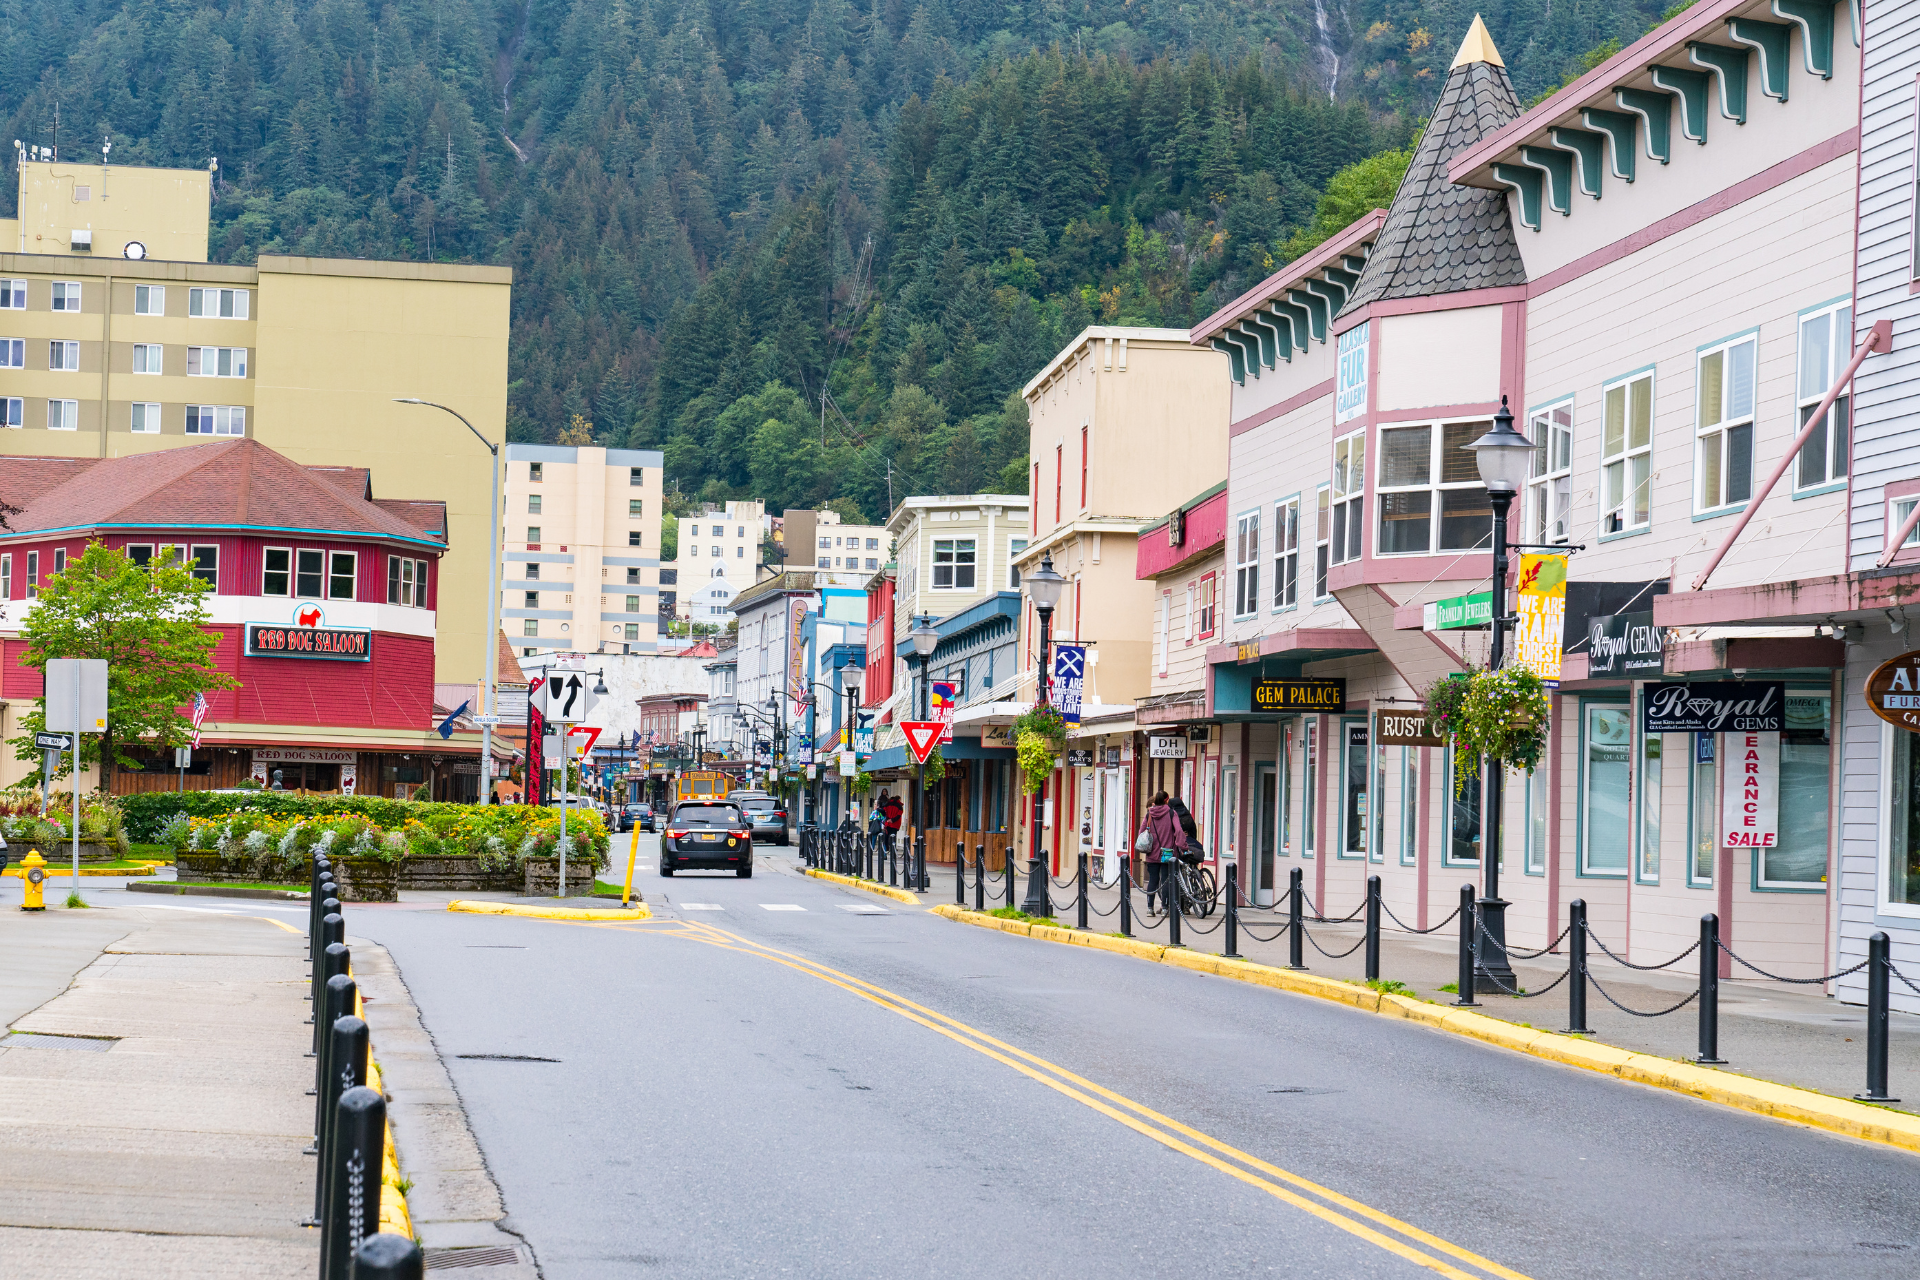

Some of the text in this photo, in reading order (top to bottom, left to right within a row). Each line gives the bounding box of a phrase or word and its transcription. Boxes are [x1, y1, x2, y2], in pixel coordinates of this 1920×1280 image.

[1339, 322, 1370, 356] ALASKA
[1340, 347, 1365, 392] FUR
[1337, 384, 1367, 413] GALLERY
[1439, 605, 1463, 624] FRANKLIN
[1464, 601, 1491, 625] JEWELERS
[1518, 594, 1565, 615] WE ARE
[1515, 612, 1565, 645] RAIN
[258, 629, 365, 654] RED DOG SALOON
[1630, 625, 1661, 655] GEMS
[1514, 640, 1563, 663] FOREST
[1054, 675, 1083, 690] WE ARE
[1888, 667, 1920, 691] A
[1052, 694, 1064, 703] AND
[1256, 686, 1340, 704] GEM PALACE
[1786, 698, 1821, 707] OMEGA
[931, 707, 954, 716] WE ARE
[1383, 716, 1425, 737] RUST
[1733, 717, 1779, 730] GEMS
[39, 736, 61, 746] ONE WAY
[856, 732, 864, 740] WE
[256, 750, 353, 761] RED DOG SALOON
[1743, 731, 1760, 827] EARANCE
[1727, 831, 1775, 847] SALE
